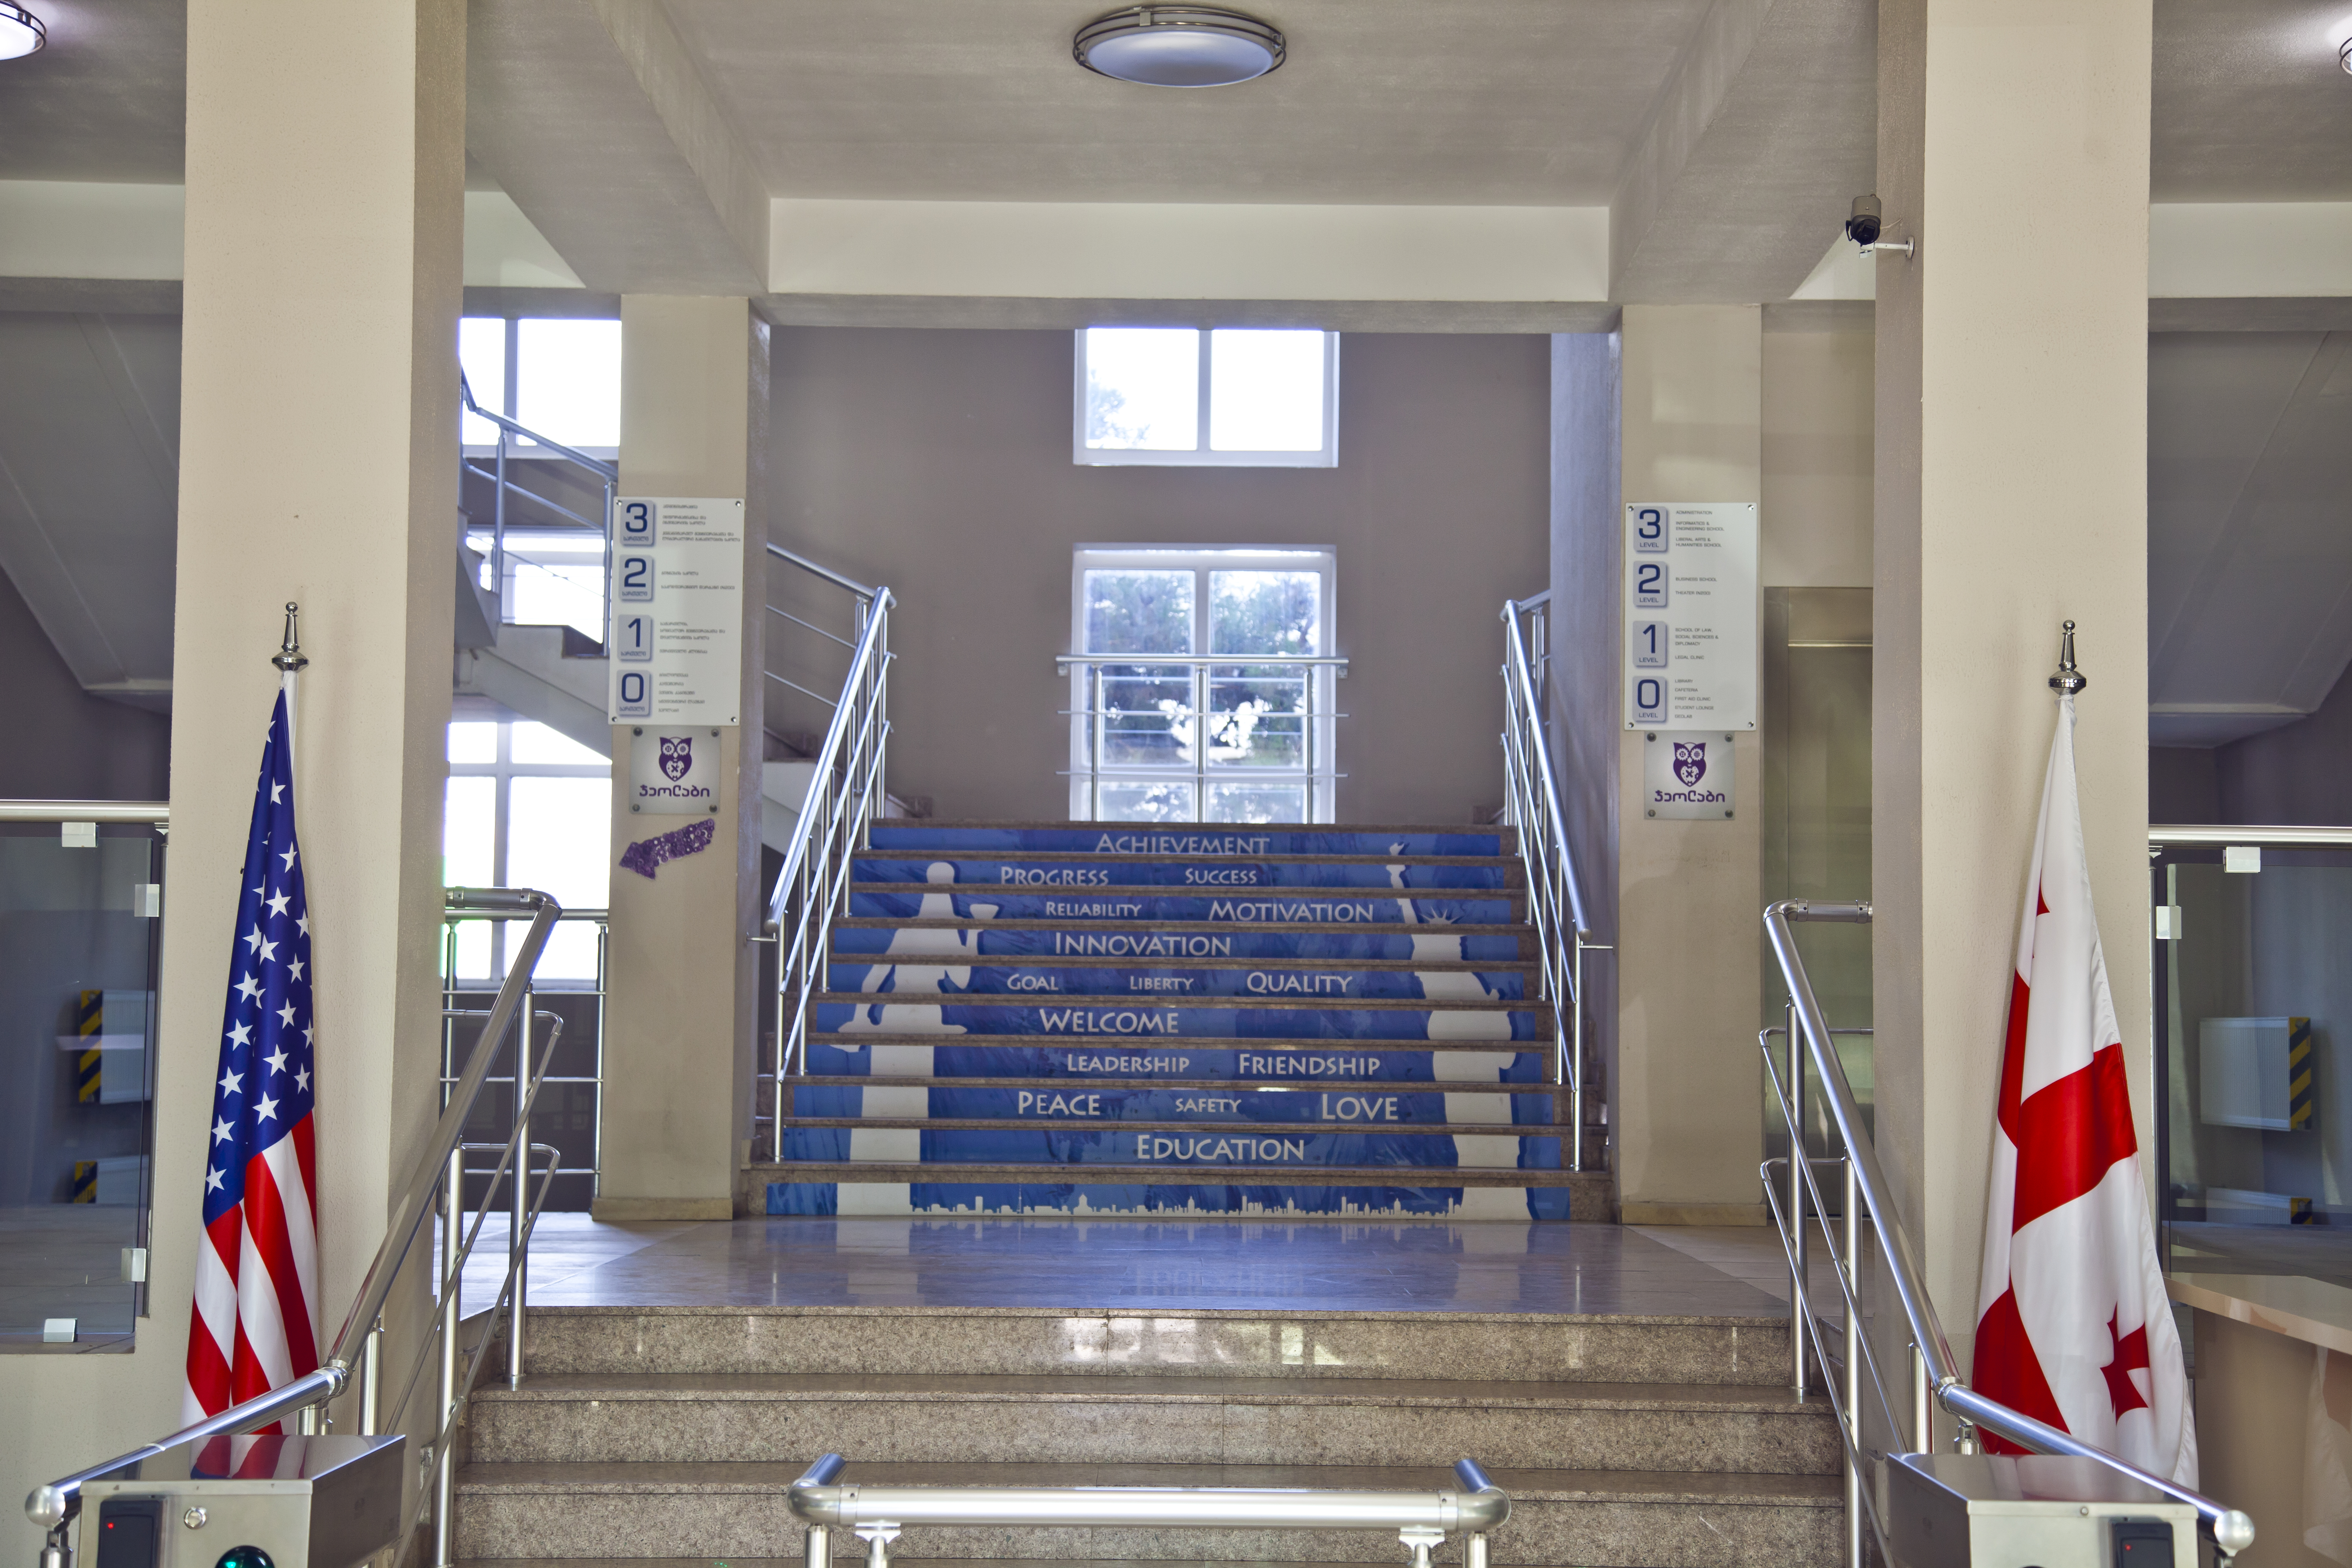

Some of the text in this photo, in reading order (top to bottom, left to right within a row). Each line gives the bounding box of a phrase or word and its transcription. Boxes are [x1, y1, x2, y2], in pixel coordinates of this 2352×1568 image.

[626, 503, 647, 532] 3
[1639, 510, 1660, 539] 3
[624, 558, 646, 587] 2
[1638, 564, 1660, 593] 2
[628, 618, 640, 647] 1
[1643, 624, 1655, 653] 1
[622, 673, 644, 702] 0
[1638, 679, 1659, 709] 0
[639, 784, 710, 797] ჯეოლაბი
[1655, 790, 1725, 802] ჯეოლაბი
[1095, 833, 1271, 854] ACHIEVEMENT
[1001, 867, 1256, 886] PROGRESS SUCCESS
[1047, 900, 1373, 922] RELIABILITY MOTIVATION
[1056, 933, 1230, 955] INNOVATION
[1008, 972, 1352, 993] GOAL LIBERTY QUALITY
[1040, 1009, 1178, 1032] WELCOME
[1068, 1054, 1380, 1075] LEADERSHIP FRIENDSHIP
[1019, 1091, 1397, 1119] PEACE SAFETY LOVE
[1138, 1135, 1304, 1160] EDUCATION
